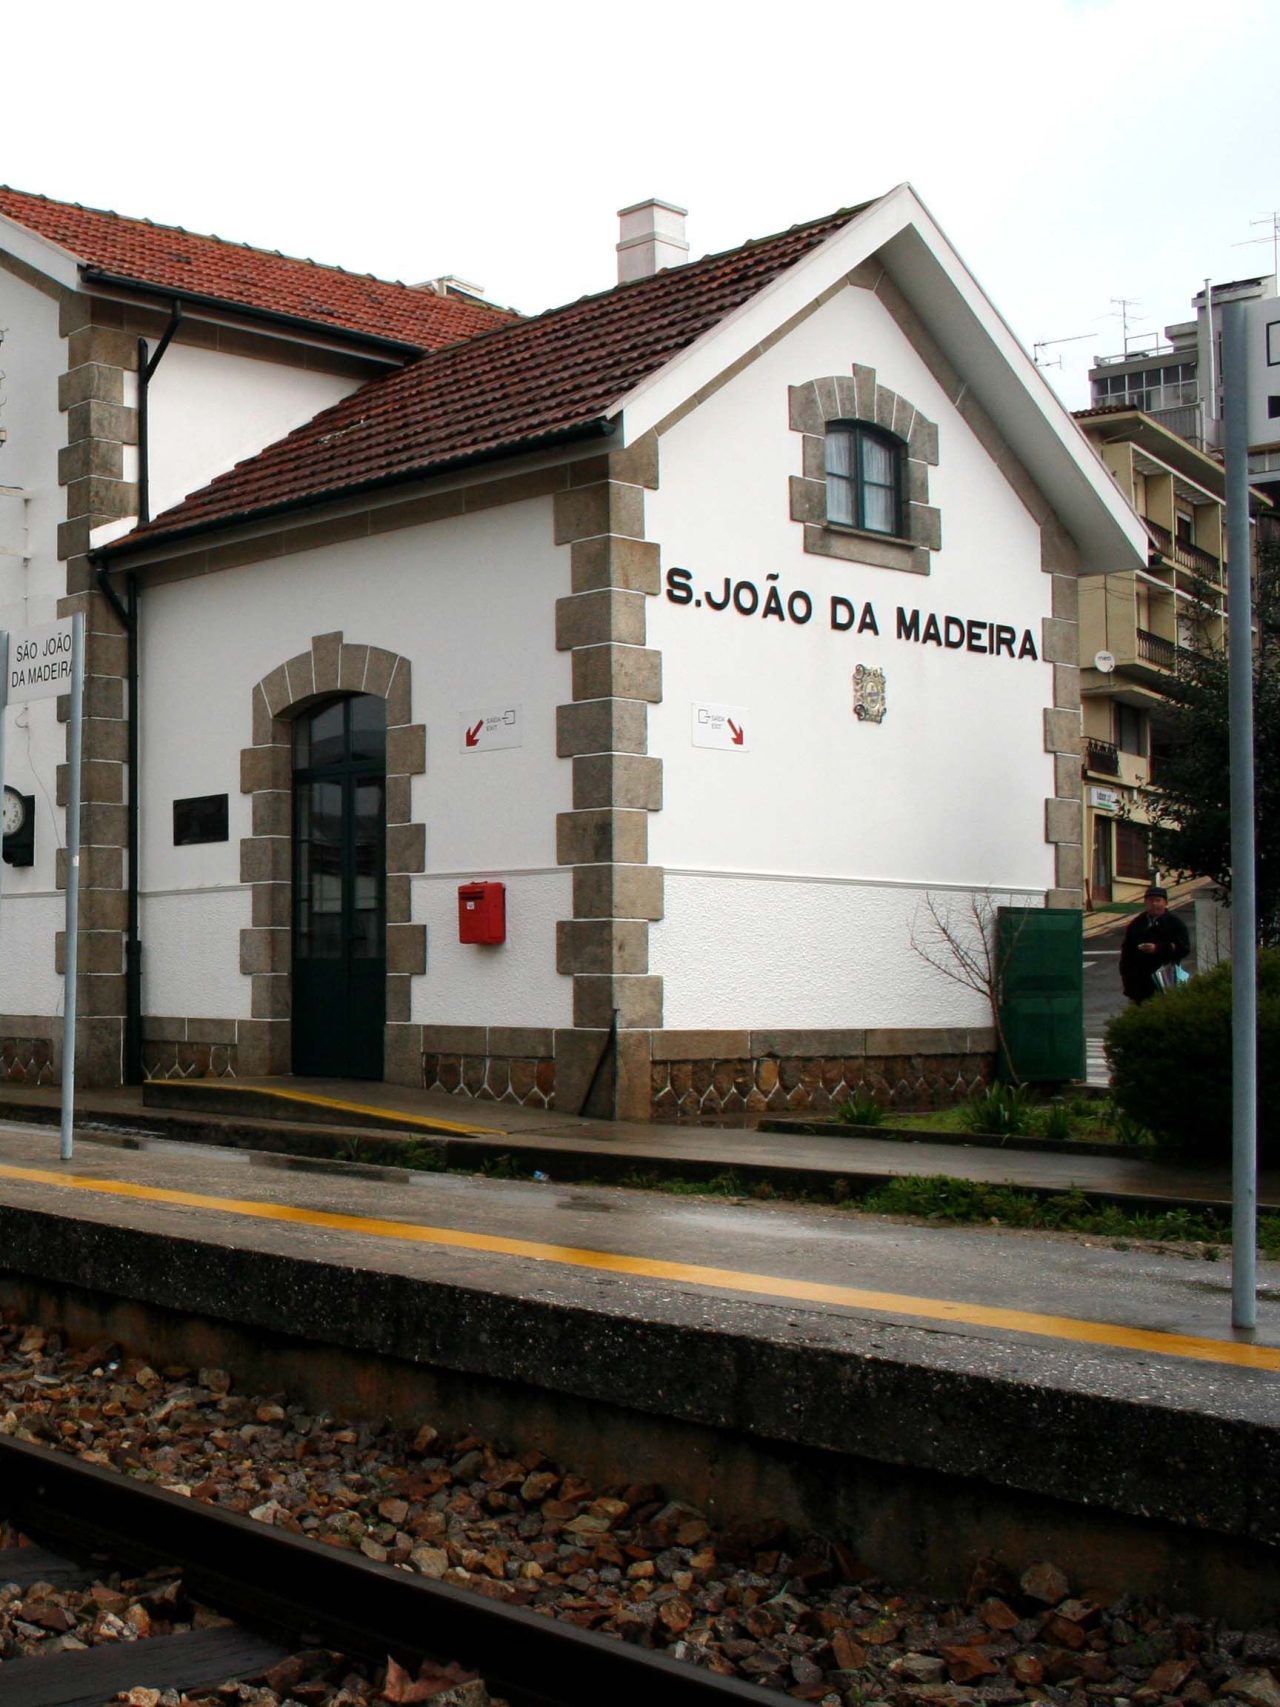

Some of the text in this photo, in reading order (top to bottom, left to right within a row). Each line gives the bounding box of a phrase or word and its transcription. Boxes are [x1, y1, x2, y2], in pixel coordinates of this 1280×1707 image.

[830, 595, 880, 636] DA
[895, 606, 1038, 660] MADEIRA
[16, 632, 72, 662] SÃO JOÃO
[11, 671, 26, 688] DA
